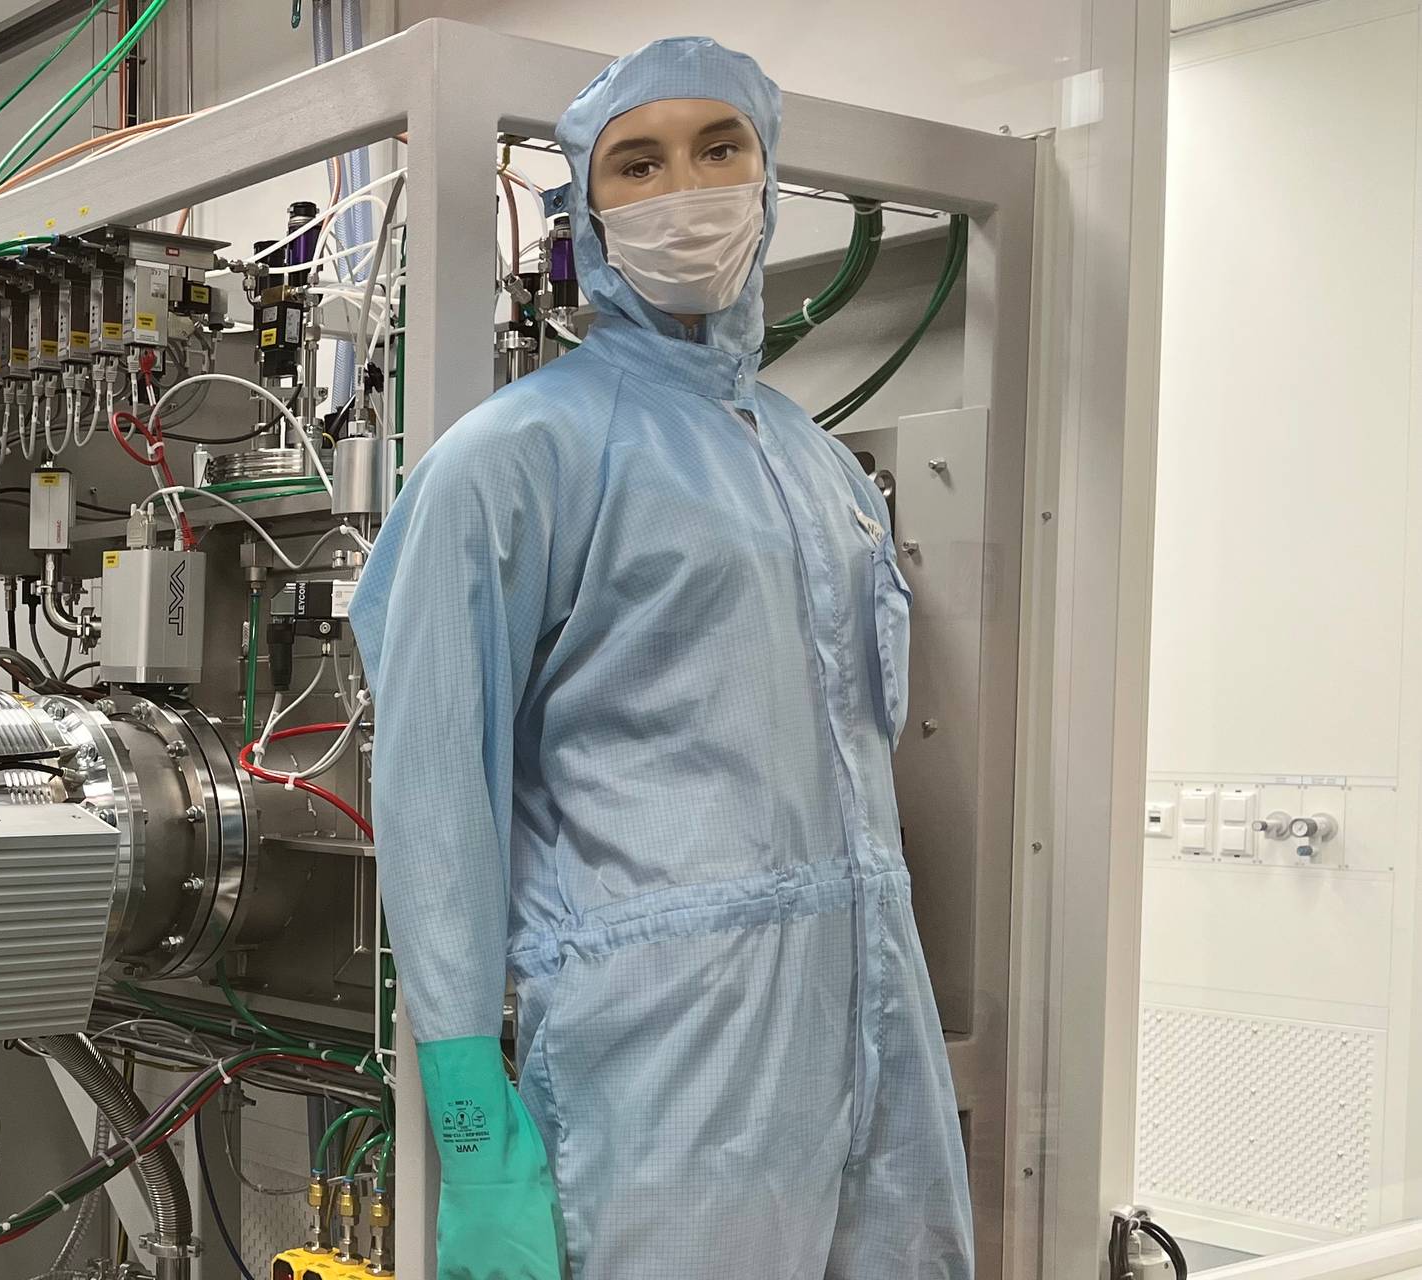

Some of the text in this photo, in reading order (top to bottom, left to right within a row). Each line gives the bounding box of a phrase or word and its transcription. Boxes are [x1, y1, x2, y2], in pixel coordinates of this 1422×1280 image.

[169, 560, 185, 635] VAT
[298, 583, 306, 615] LEYCON
[456, 1144, 479, 1153] VWR
